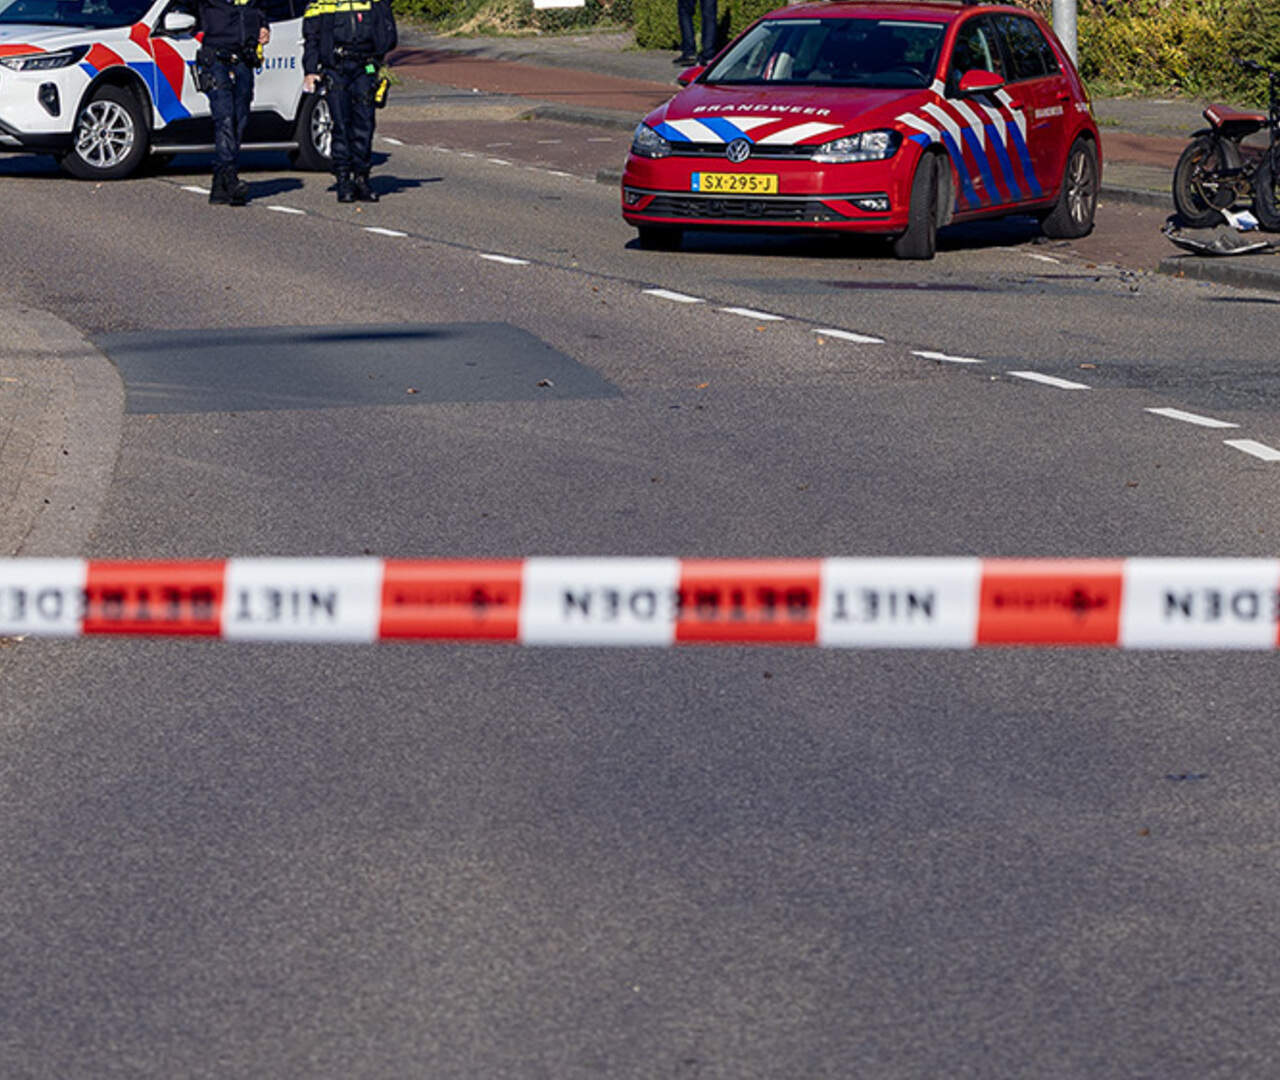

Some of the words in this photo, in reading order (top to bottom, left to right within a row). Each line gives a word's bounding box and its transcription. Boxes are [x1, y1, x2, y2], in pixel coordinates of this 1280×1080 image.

[256, 56, 296, 75] LITIE
[693, 103, 831, 117] BRANDWEER
[704, 174, 772, 191] SX-295-J
[236, 586, 340, 622] NIET
[832, 587, 937, 621] NIET
